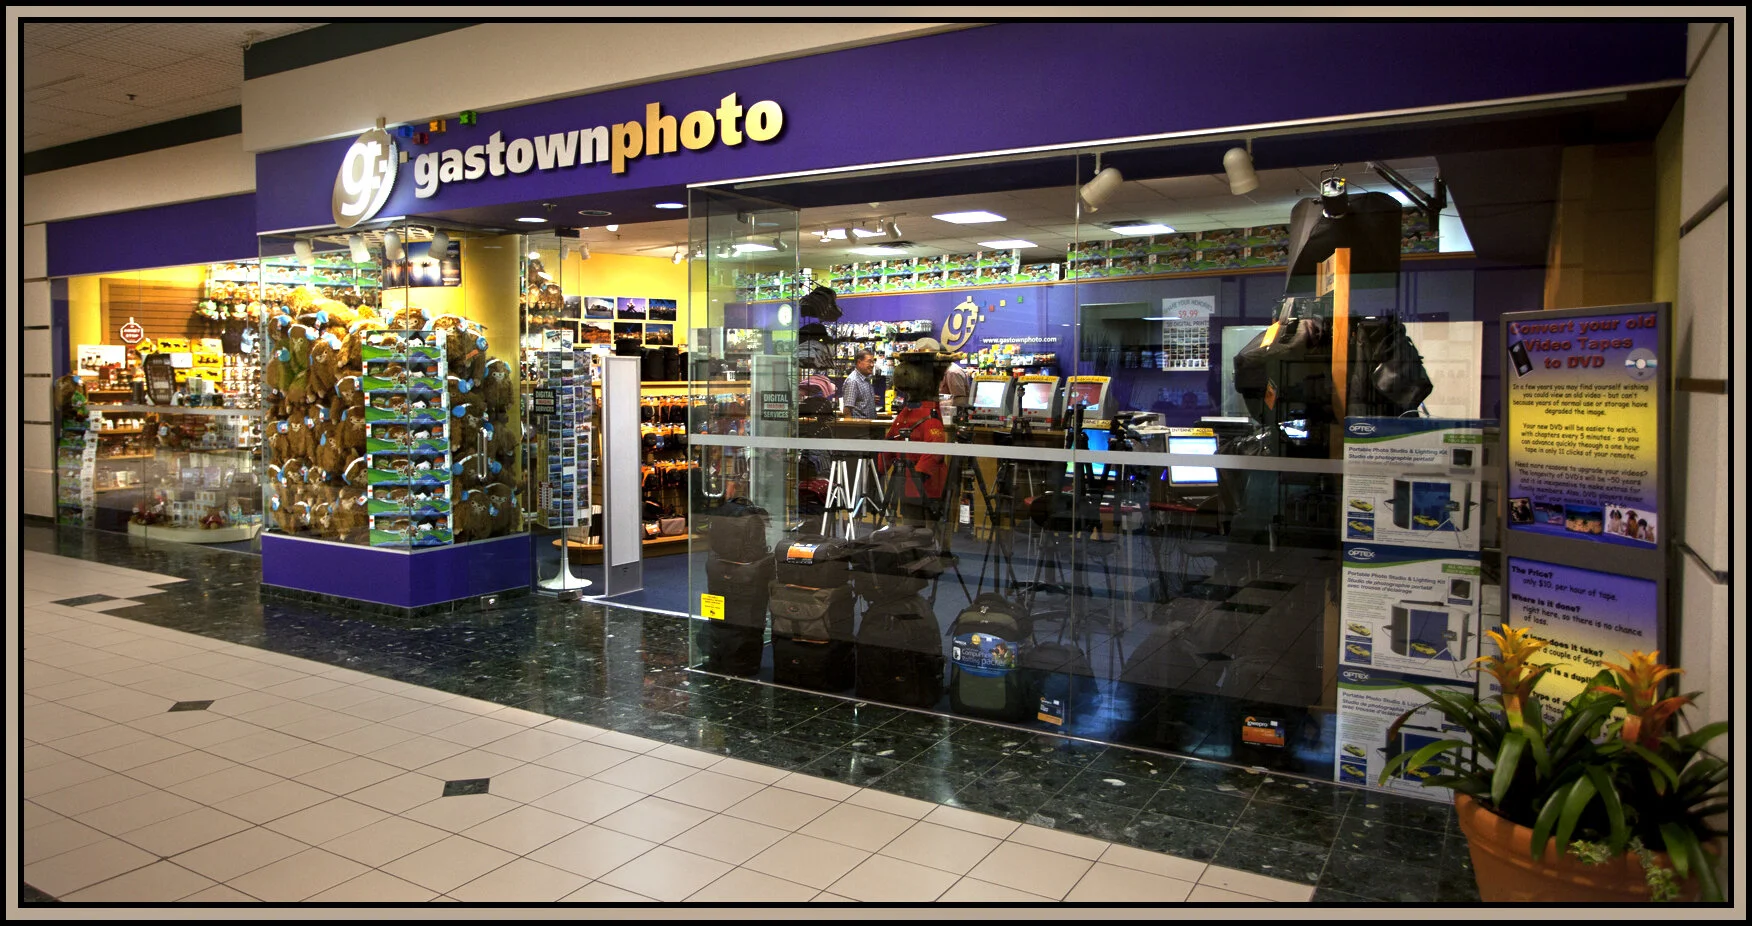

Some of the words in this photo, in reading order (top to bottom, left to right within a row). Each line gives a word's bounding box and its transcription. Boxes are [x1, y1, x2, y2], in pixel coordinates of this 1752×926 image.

[1510, 322, 1574, 335] Convert
[1579, 318, 1620, 335] your
[1626, 314, 1656, 330] old
[982, 336, 1057, 344] www.gastownphoto.com
[1524, 339, 1572, 352] Video
[1578, 337, 1633, 352] Tapes
[1544, 357, 1561, 368] to
[1568, 356, 1605, 368] DVD
[1623, 384, 1649, 392] wishing
[764, 394, 788, 402] DIGITAL
[1349, 425, 1376, 433] OPTEX
[1556, 440, 1576, 448] quickly
[1348, 549, 1375, 558] OPTEX
[1512, 566, 1526, 575] The
[1528, 568, 1553, 579] Price?
[1373, 580, 1410, 589] photographie
[1413, 576, 1436, 584] Lighting
[1523, 578, 1537, 587] only
[1570, 585, 1586, 595] hour
[1588, 588, 1596, 596] of
[1599, 591, 1618, 601] tape.
[1512, 594, 1536, 604] Where
[1556, 601, 1580, 612] done?
[1522, 605, 1540, 614] right
[1542, 609, 1560, 620] here,
[1573, 614, 1593, 625] there
[1603, 622, 1613, 630] no
[1614, 624, 1642, 636] chance
[1533, 616, 1548, 626] loss.
[1550, 638, 1568, 649] does
[1571, 642, 1578, 651] it
[1580, 644, 1603, 658] take?
[1550, 649, 1571, 661] couple
[1573, 654, 1581, 663] of
[1343, 671, 1369, 680] OPTEX
[1532, 691, 1550, 701] type
[1368, 703, 1404, 712] photographie
